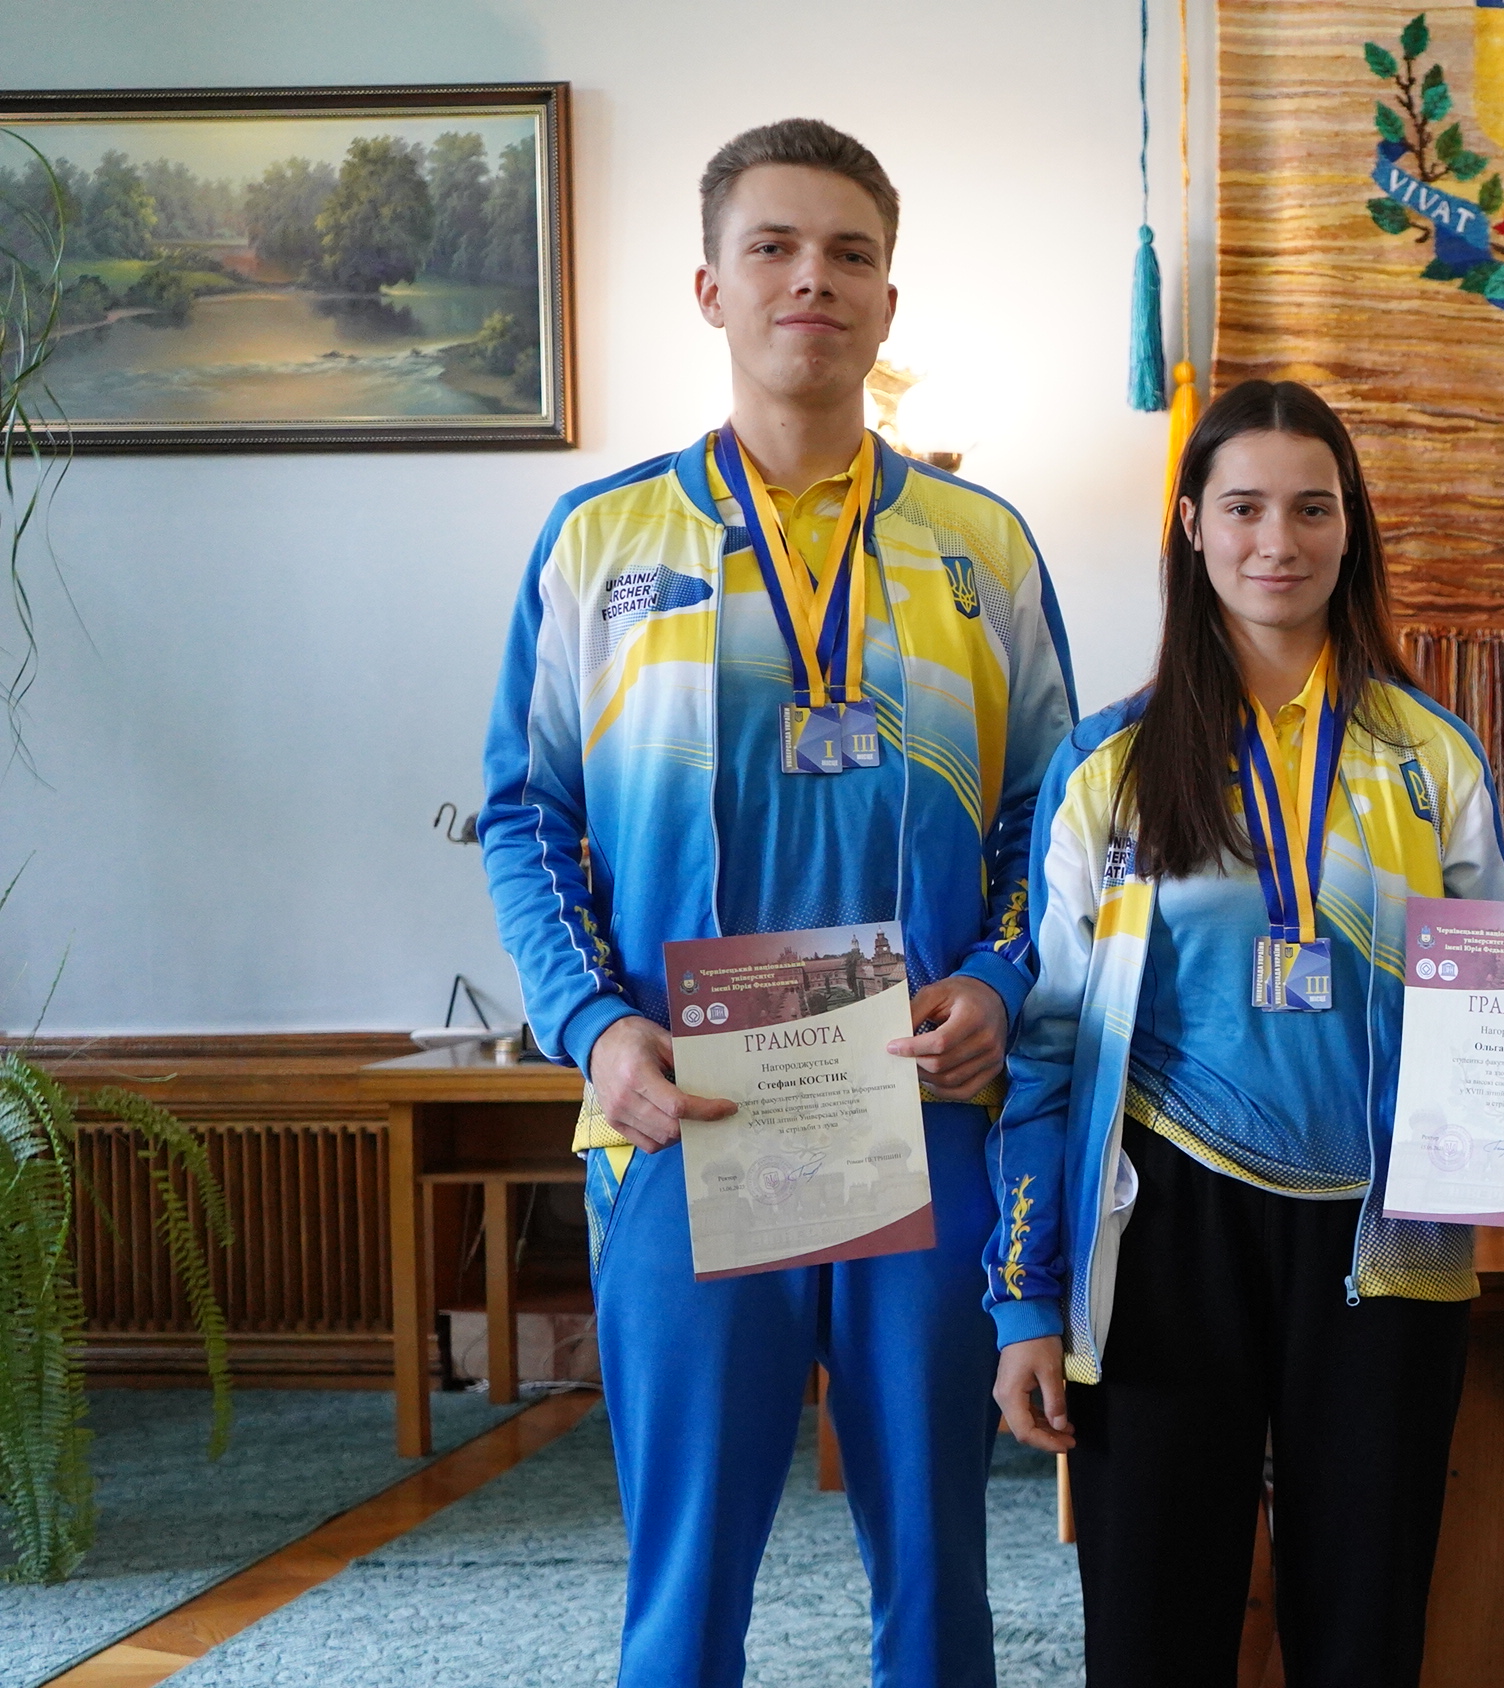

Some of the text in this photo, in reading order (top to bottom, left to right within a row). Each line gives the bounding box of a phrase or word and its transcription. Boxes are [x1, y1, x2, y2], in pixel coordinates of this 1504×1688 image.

[1387, 167, 1476, 234] VIVAT
[609, 584, 651, 602] RCHER
[823, 740, 833, 758] I
[852, 734, 876, 752] III
[700, 966, 753, 977] Чернівецький
[1305, 975, 1329, 994] III
[744, 1025, 846, 1053] ГРАМОТА
[1474, 1042, 1504, 1053] Ольга
[762, 1057, 839, 1073] Нагороджується
[758, 1072, 848, 1091] Стефан КОСТИК
